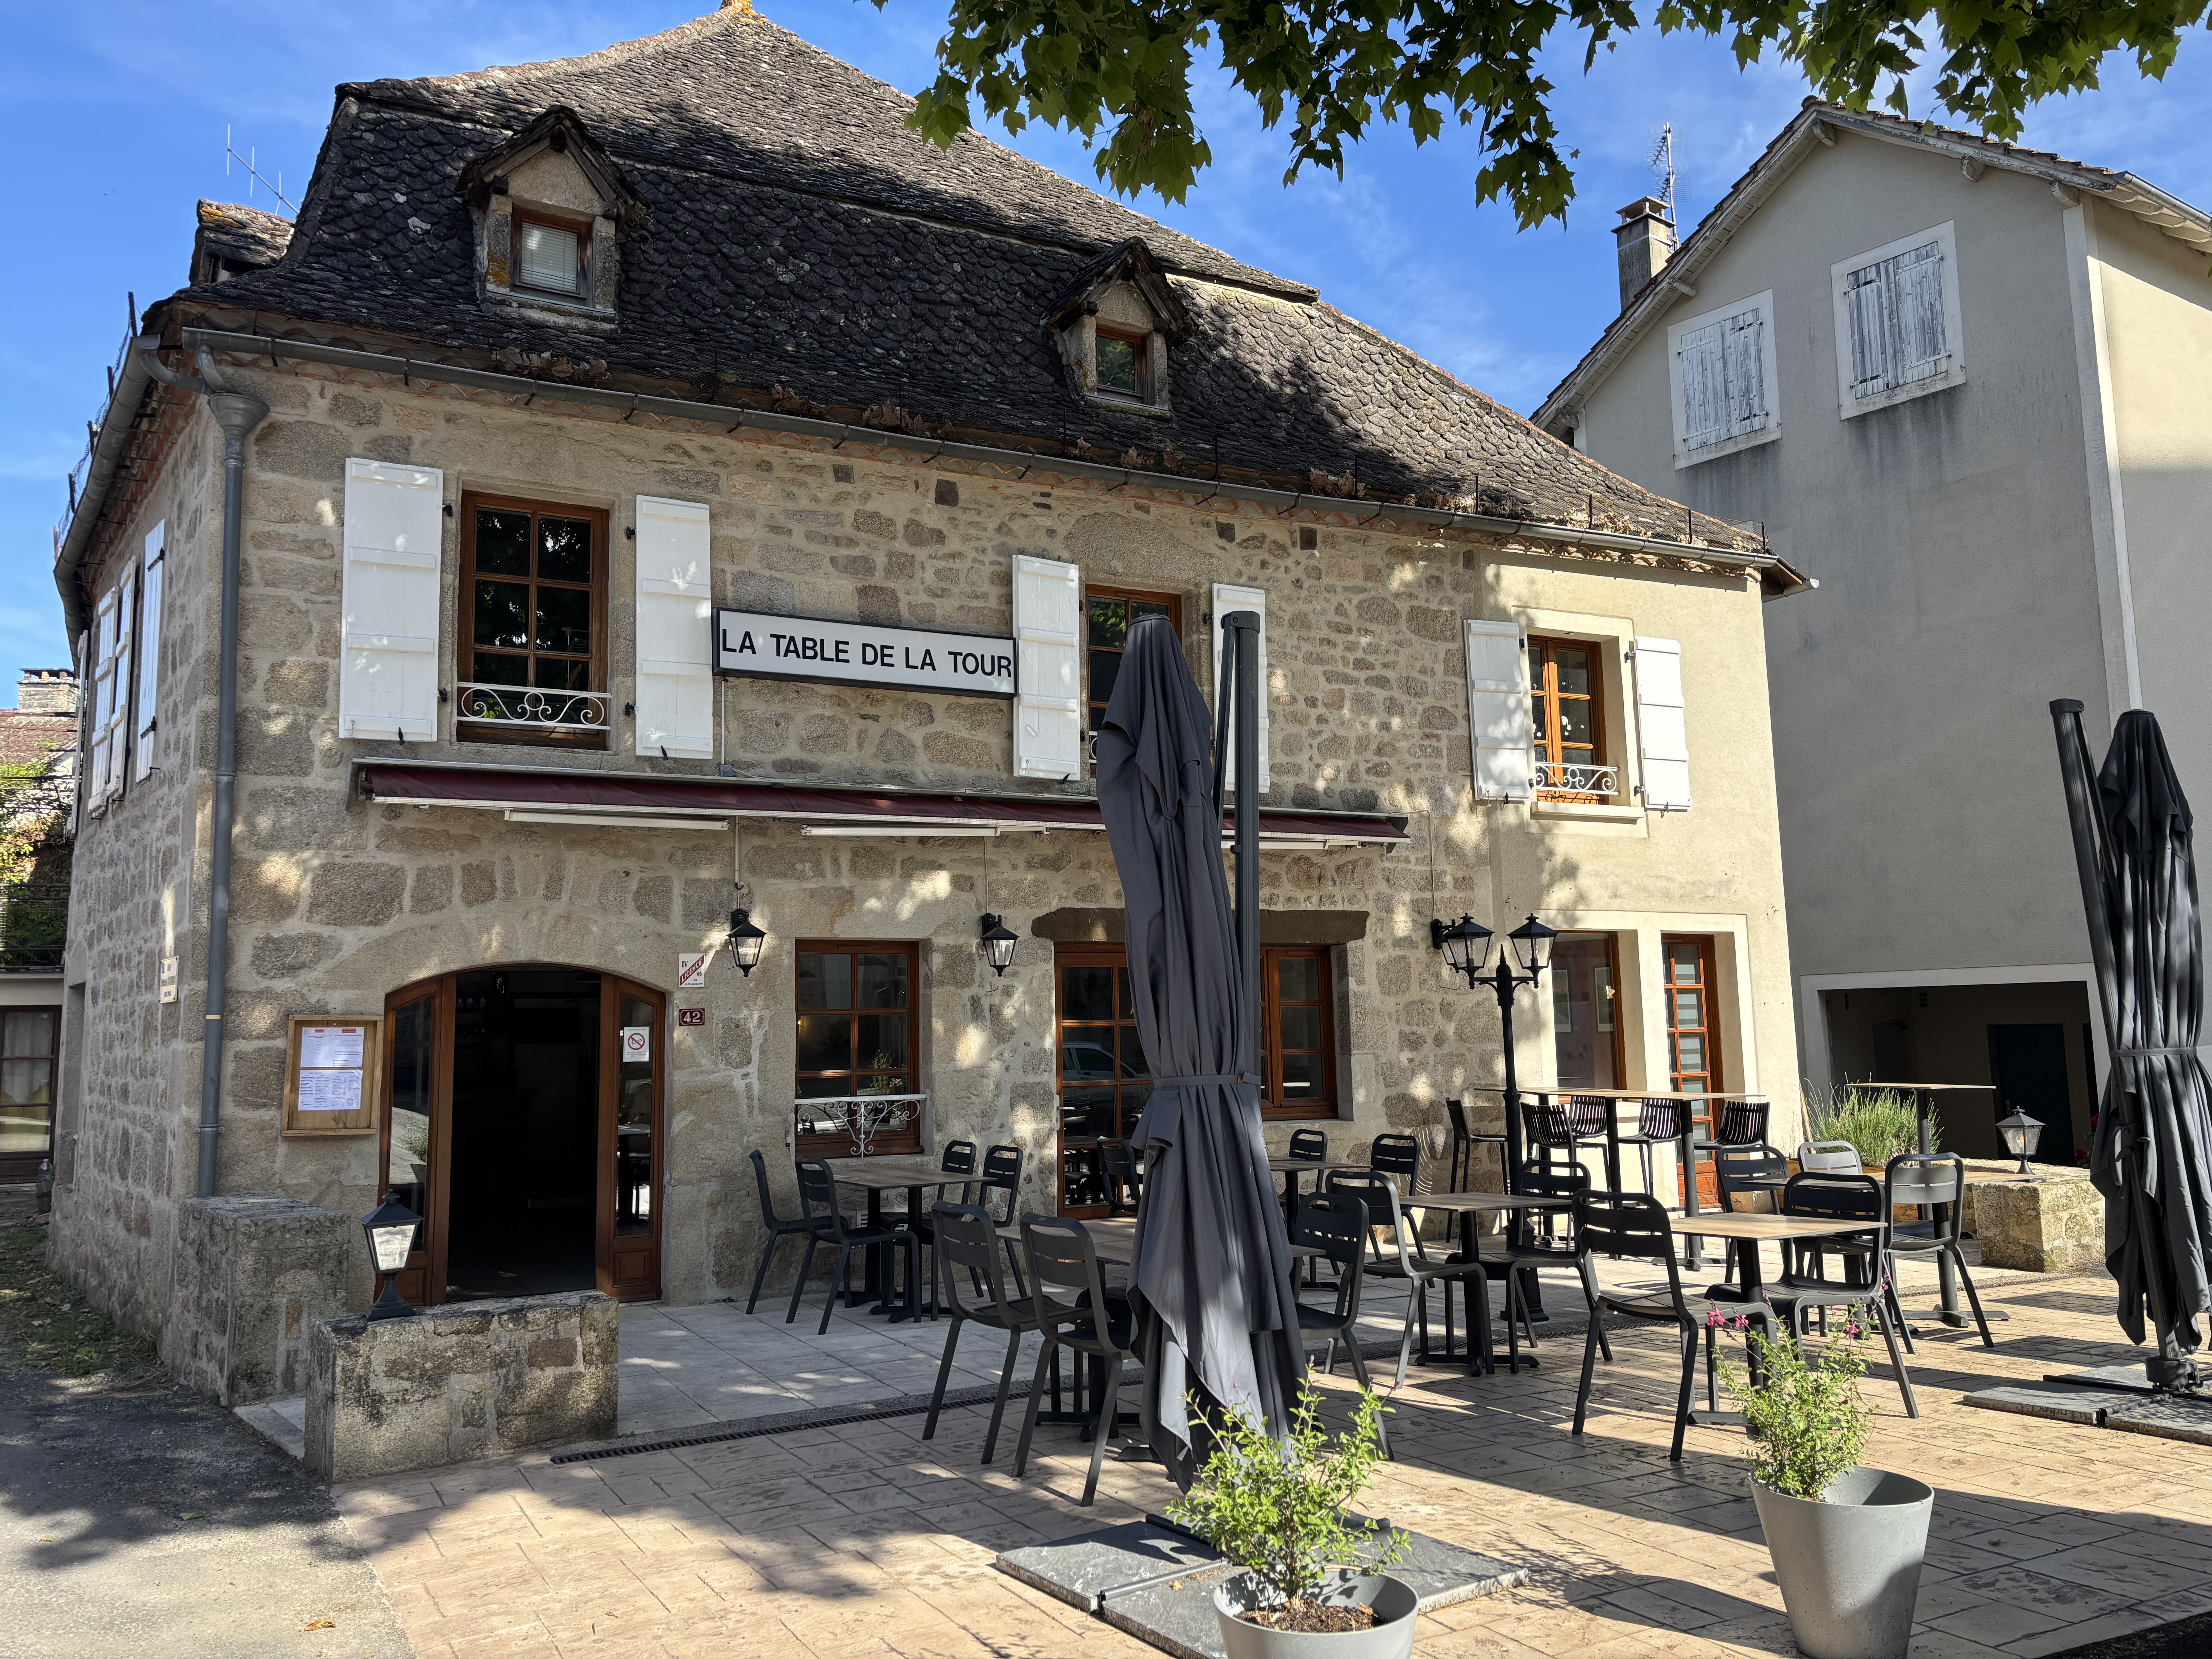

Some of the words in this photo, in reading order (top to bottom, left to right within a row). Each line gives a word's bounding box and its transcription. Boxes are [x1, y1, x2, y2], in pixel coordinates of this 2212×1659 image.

[722, 628, 757, 655] LA
[769, 633, 850, 664] TABLE
[861, 642, 895, 668] DE
[905, 647, 937, 672] LA
[947, 651, 1012, 678] TOUR
[682, 958, 702, 982] LICENCE
[683, 1012, 701, 1023] 42
